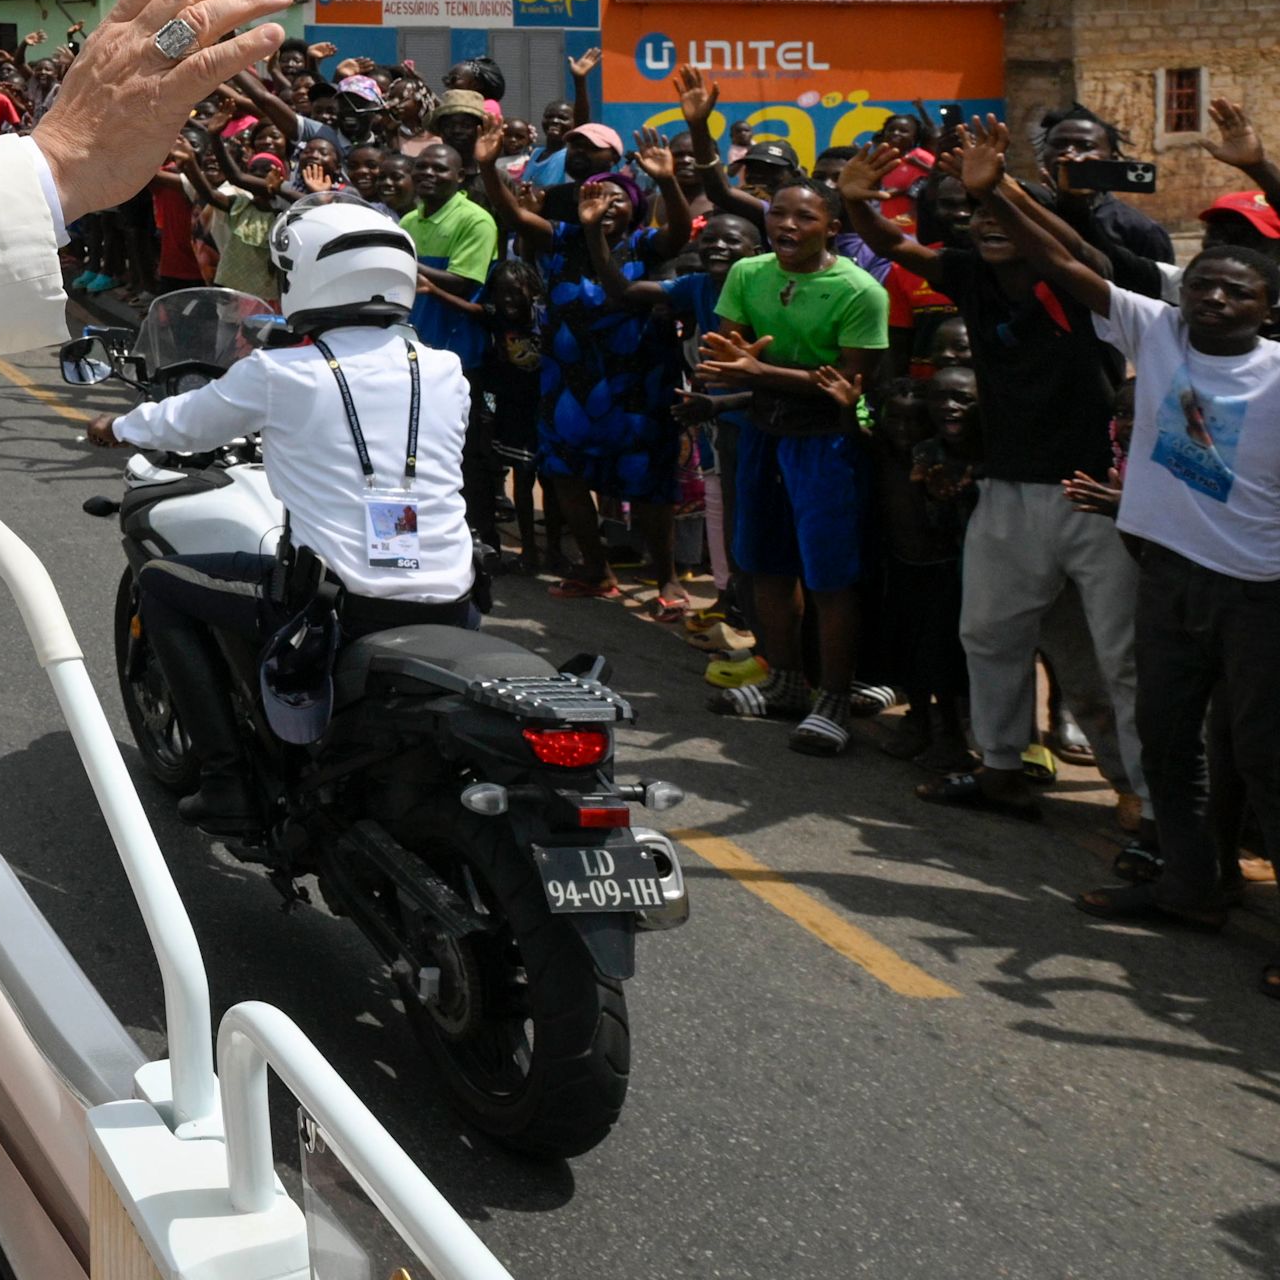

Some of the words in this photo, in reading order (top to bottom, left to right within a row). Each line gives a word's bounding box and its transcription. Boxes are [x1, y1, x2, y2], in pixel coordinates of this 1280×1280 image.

[689, 40, 830, 70] UNITEL
[398, 559, 417, 567] SGC
[578, 850, 615, 876] LD
[548, 878, 662, 907] 94-09-IH
